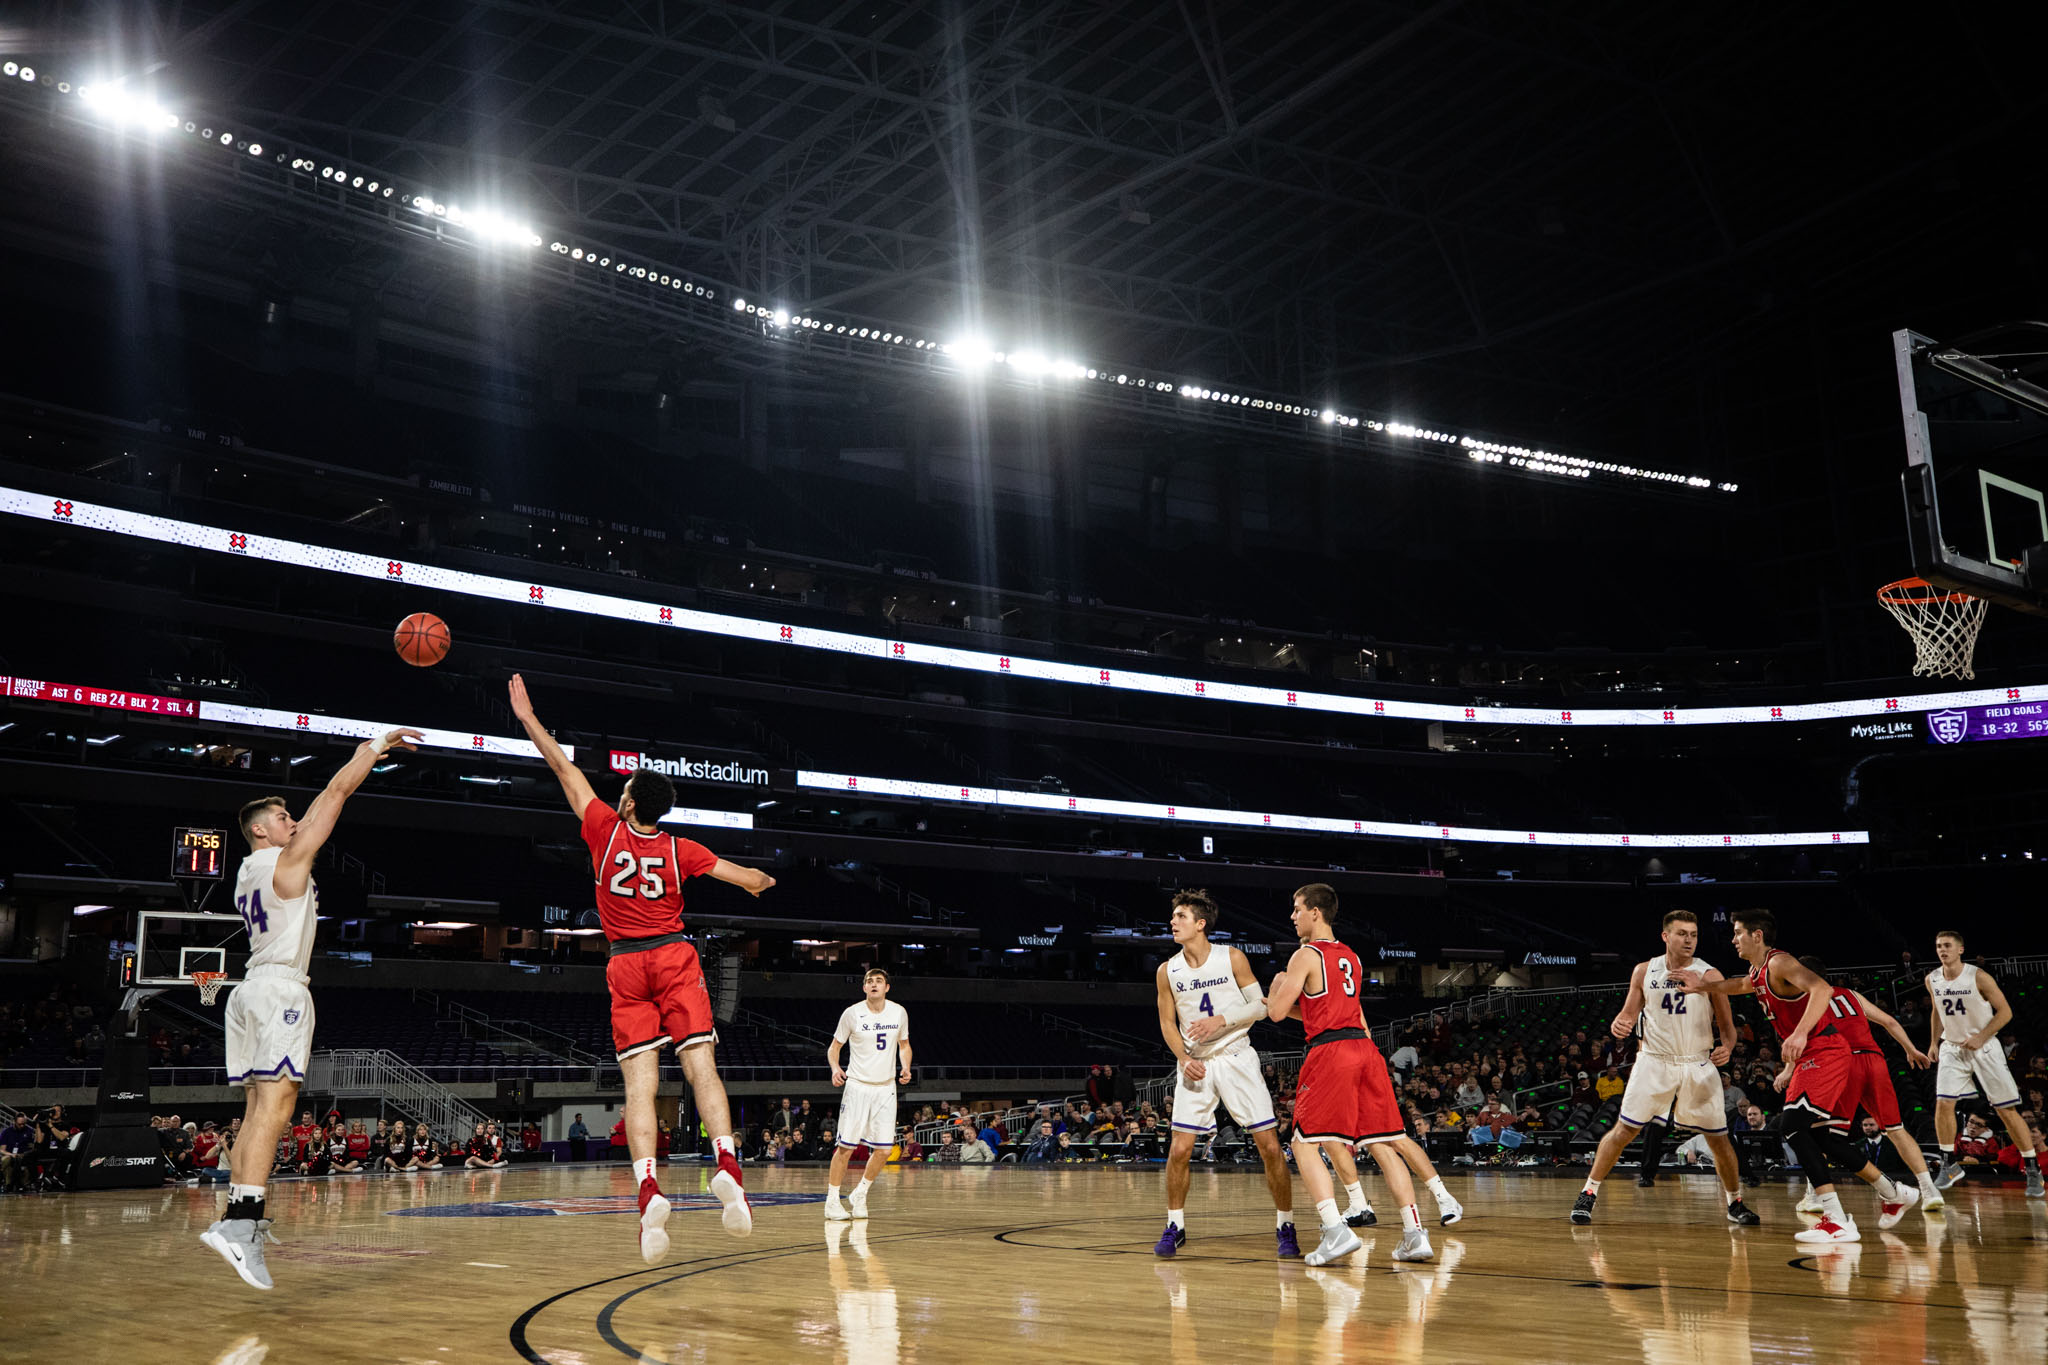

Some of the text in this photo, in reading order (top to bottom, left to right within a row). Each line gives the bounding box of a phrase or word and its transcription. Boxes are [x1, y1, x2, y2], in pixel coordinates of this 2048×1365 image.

[13, 687, 38, 697] STATS
[15, 678, 45, 691] HUSTLE
[52, 687, 193, 715] AST 6 REB 24 BLK 2 STL 4
[1986, 704, 2042, 718] FIELD GOALS
[1982, 721, 2018, 736] 18-32
[184, 833, 220, 849] 17:56
[610, 849, 667, 902] 25
[237, 888, 269, 939] 34
[1176, 976, 1229, 992] St. Thomas
[1338, 957, 1356, 997] 3
[1943, 988, 1972, 997] Thomas
[1199, 992, 1214, 1017] 4
[1661, 992, 1687, 1015] 42
[1829, 994, 1859, 1019] 11
[1942, 998, 1966, 1016] 24
[873, 1022, 899, 1031] Thomas
[876, 1033, 887, 1051] 5
